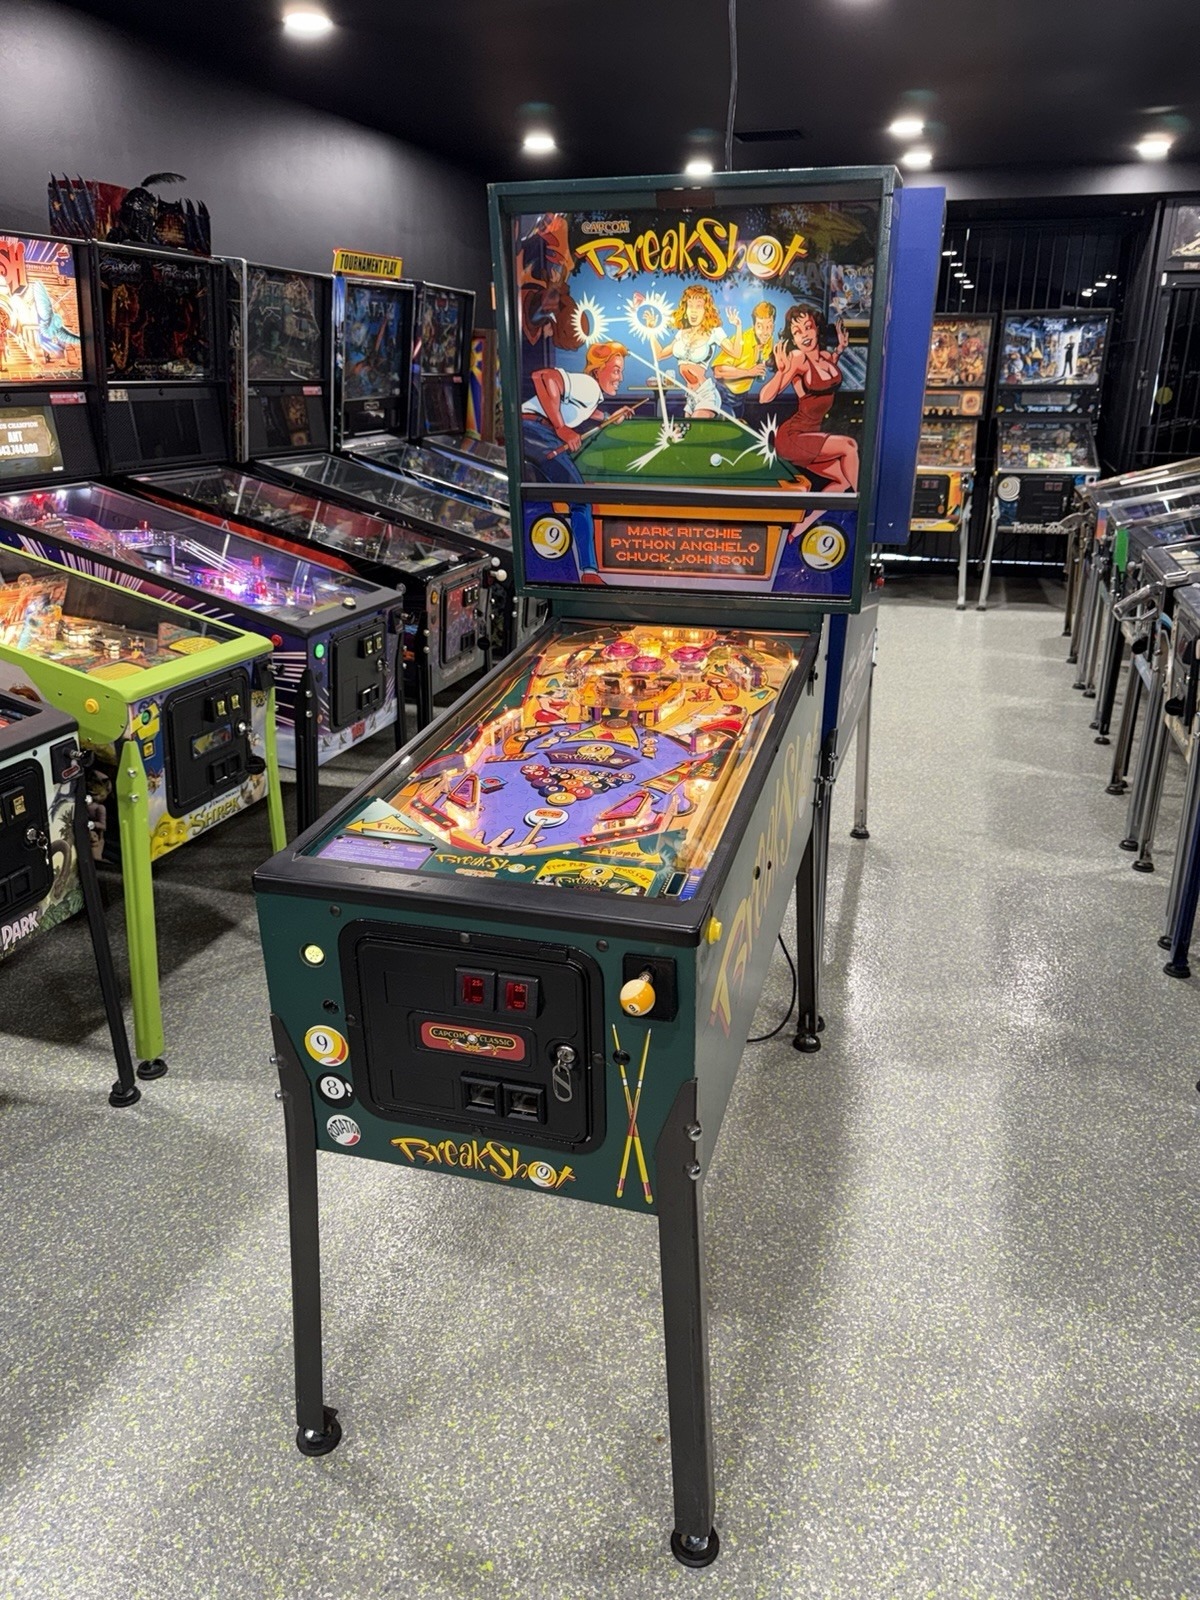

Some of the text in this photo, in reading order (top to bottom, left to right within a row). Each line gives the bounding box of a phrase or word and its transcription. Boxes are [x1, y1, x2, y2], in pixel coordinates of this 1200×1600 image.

[581, 221, 630, 234] CAPCOM
[340, 253, 398, 275] TOURNAMENT PLAY
[549, 527, 560, 543] 9
[627, 525, 743, 540] MARK RITCHIE
[610, 538, 760, 553] PYTHON ANGHELO
[821, 535, 833, 552] 9
[615, 551, 755, 566] CHUCK JOHNSON
[1, 911, 39, 950] PARK
[316, 1034, 328, 1052] 9
[432, 1029, 513, 1047] CAPCOM CLASSIC
[326, 1079, 340, 1096] 8
[327, 1118, 361, 1141] ROTATION
